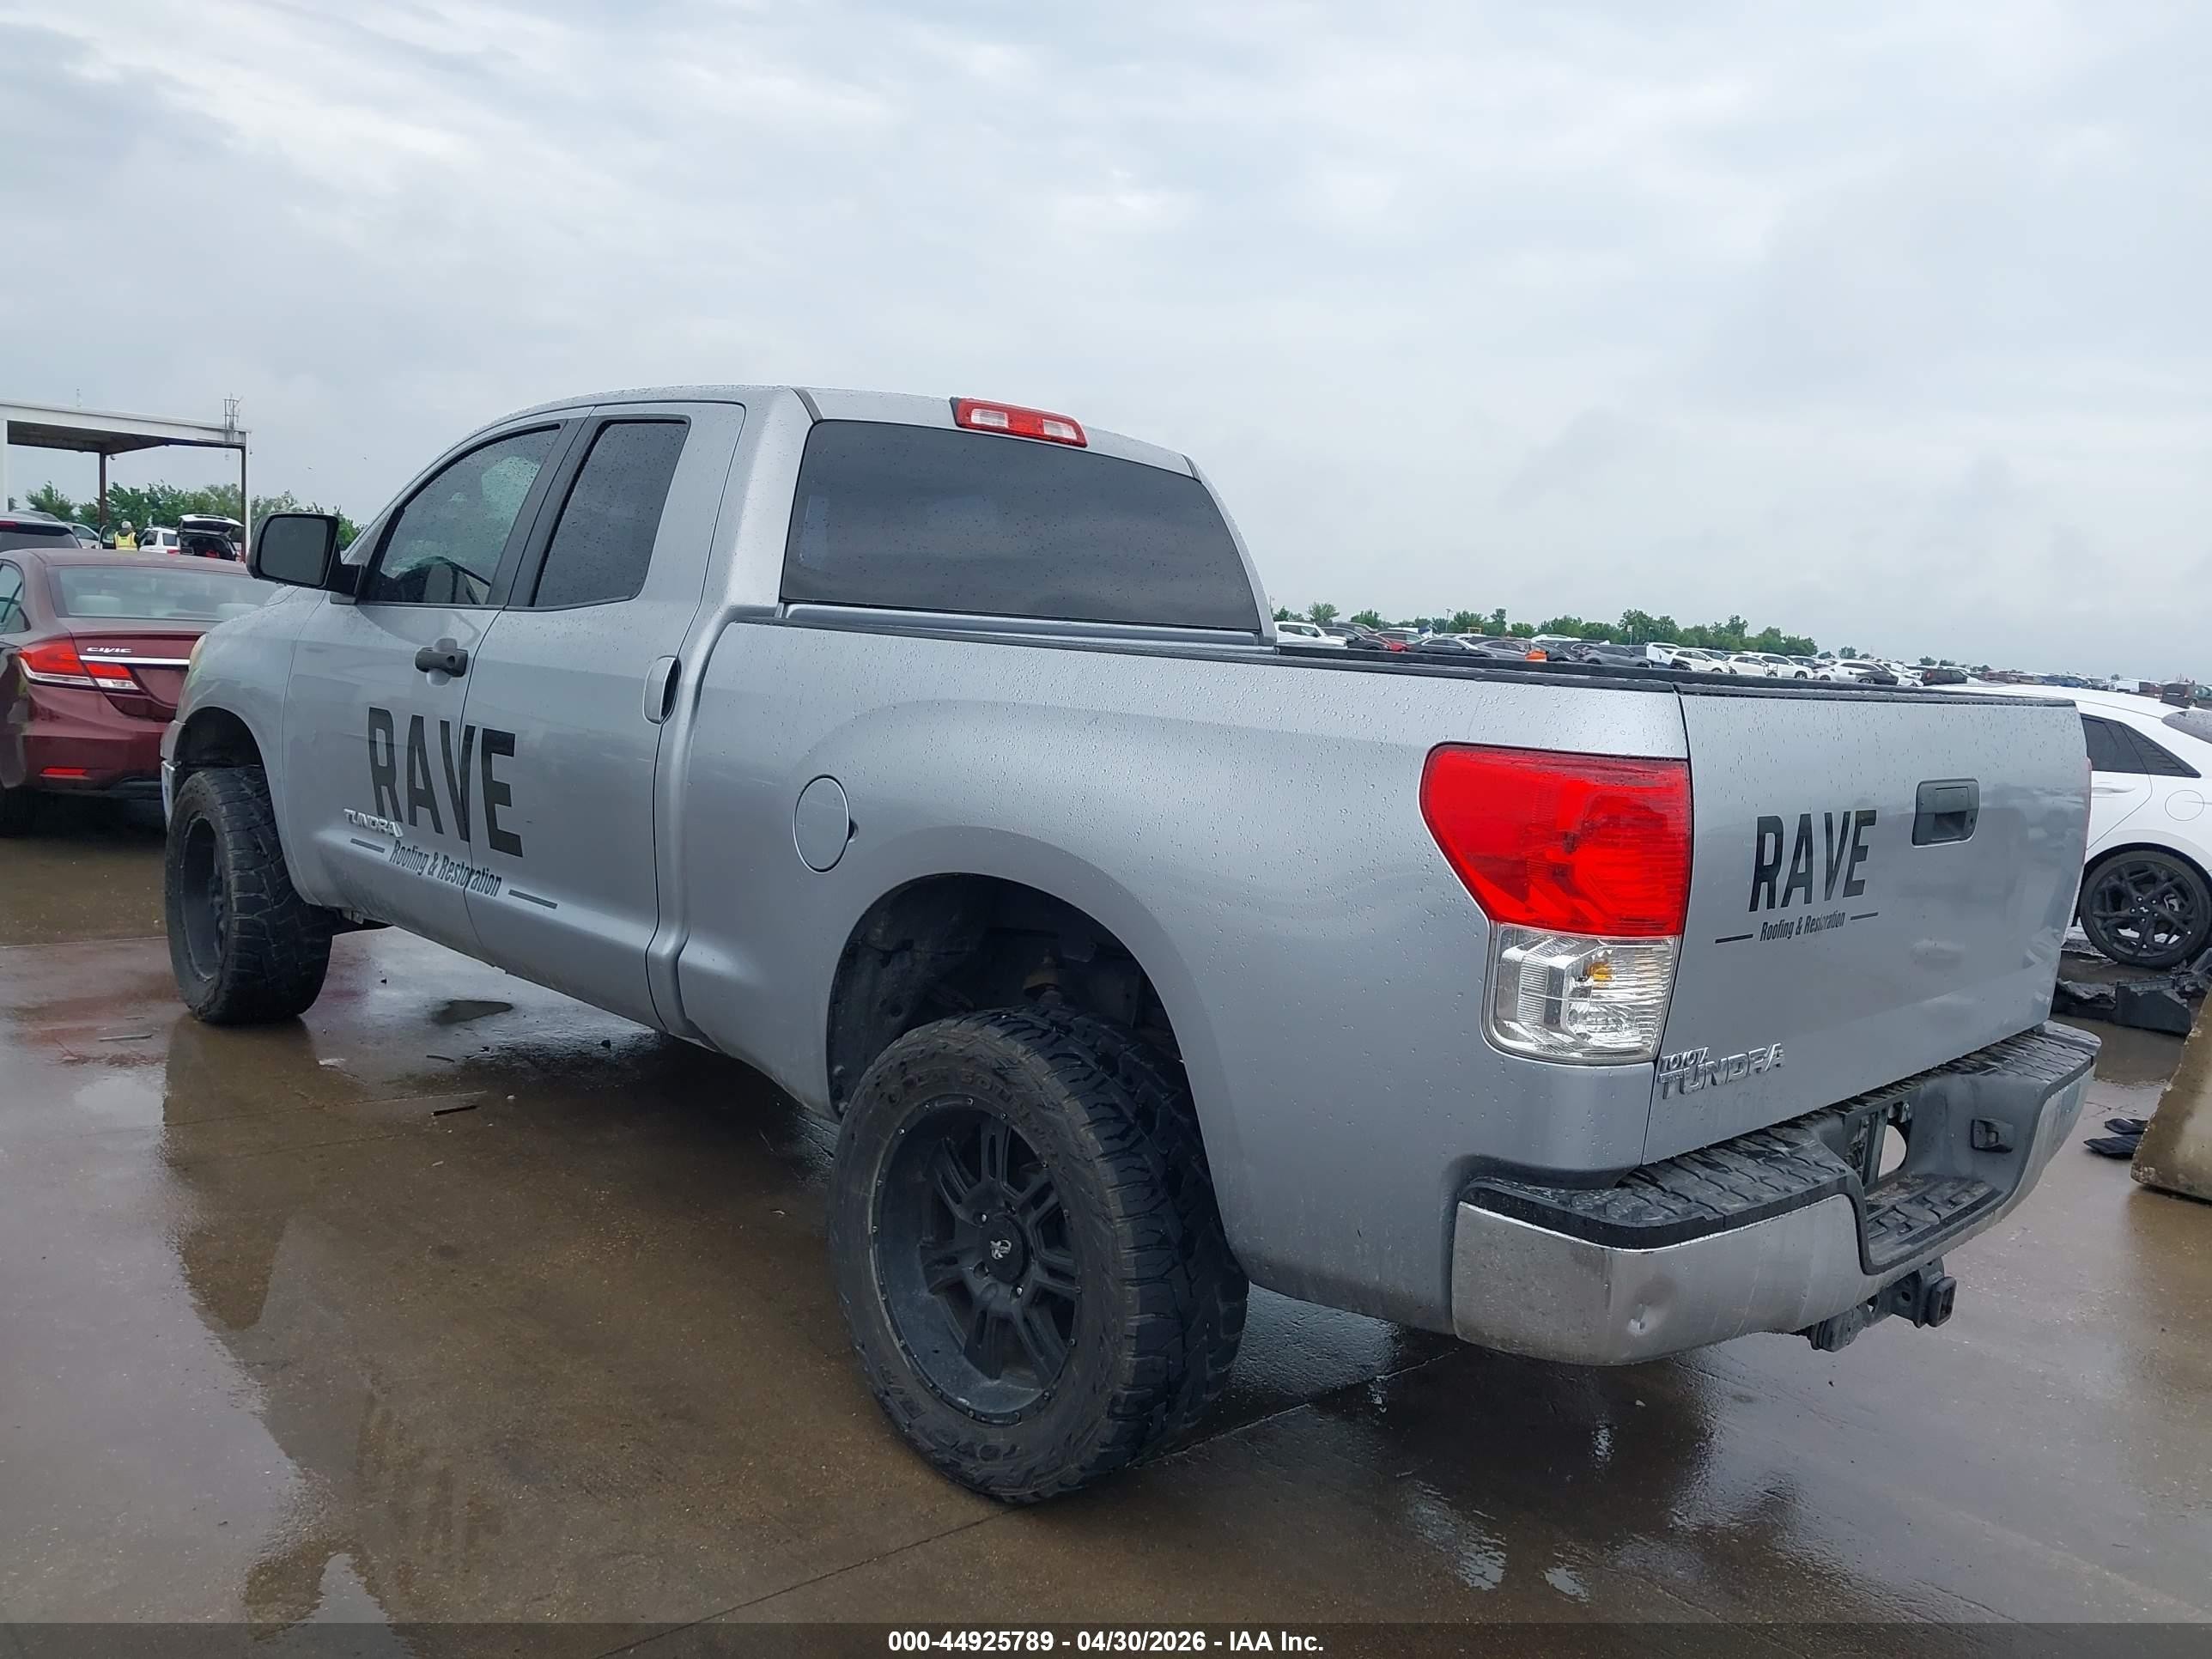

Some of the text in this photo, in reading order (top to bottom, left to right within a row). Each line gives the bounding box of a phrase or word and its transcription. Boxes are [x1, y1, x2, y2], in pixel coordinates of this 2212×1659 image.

[368, 706, 523, 858] RAVE
[343, 808, 404, 838] TUNDRA
[389, 840, 502, 897] Roofing & Restoration
[1748, 810, 1877, 912] RAVE
[1759, 909, 1846, 942] Roofing & Restoration
[1657, 1042, 1785, 1099] TUNDRA
